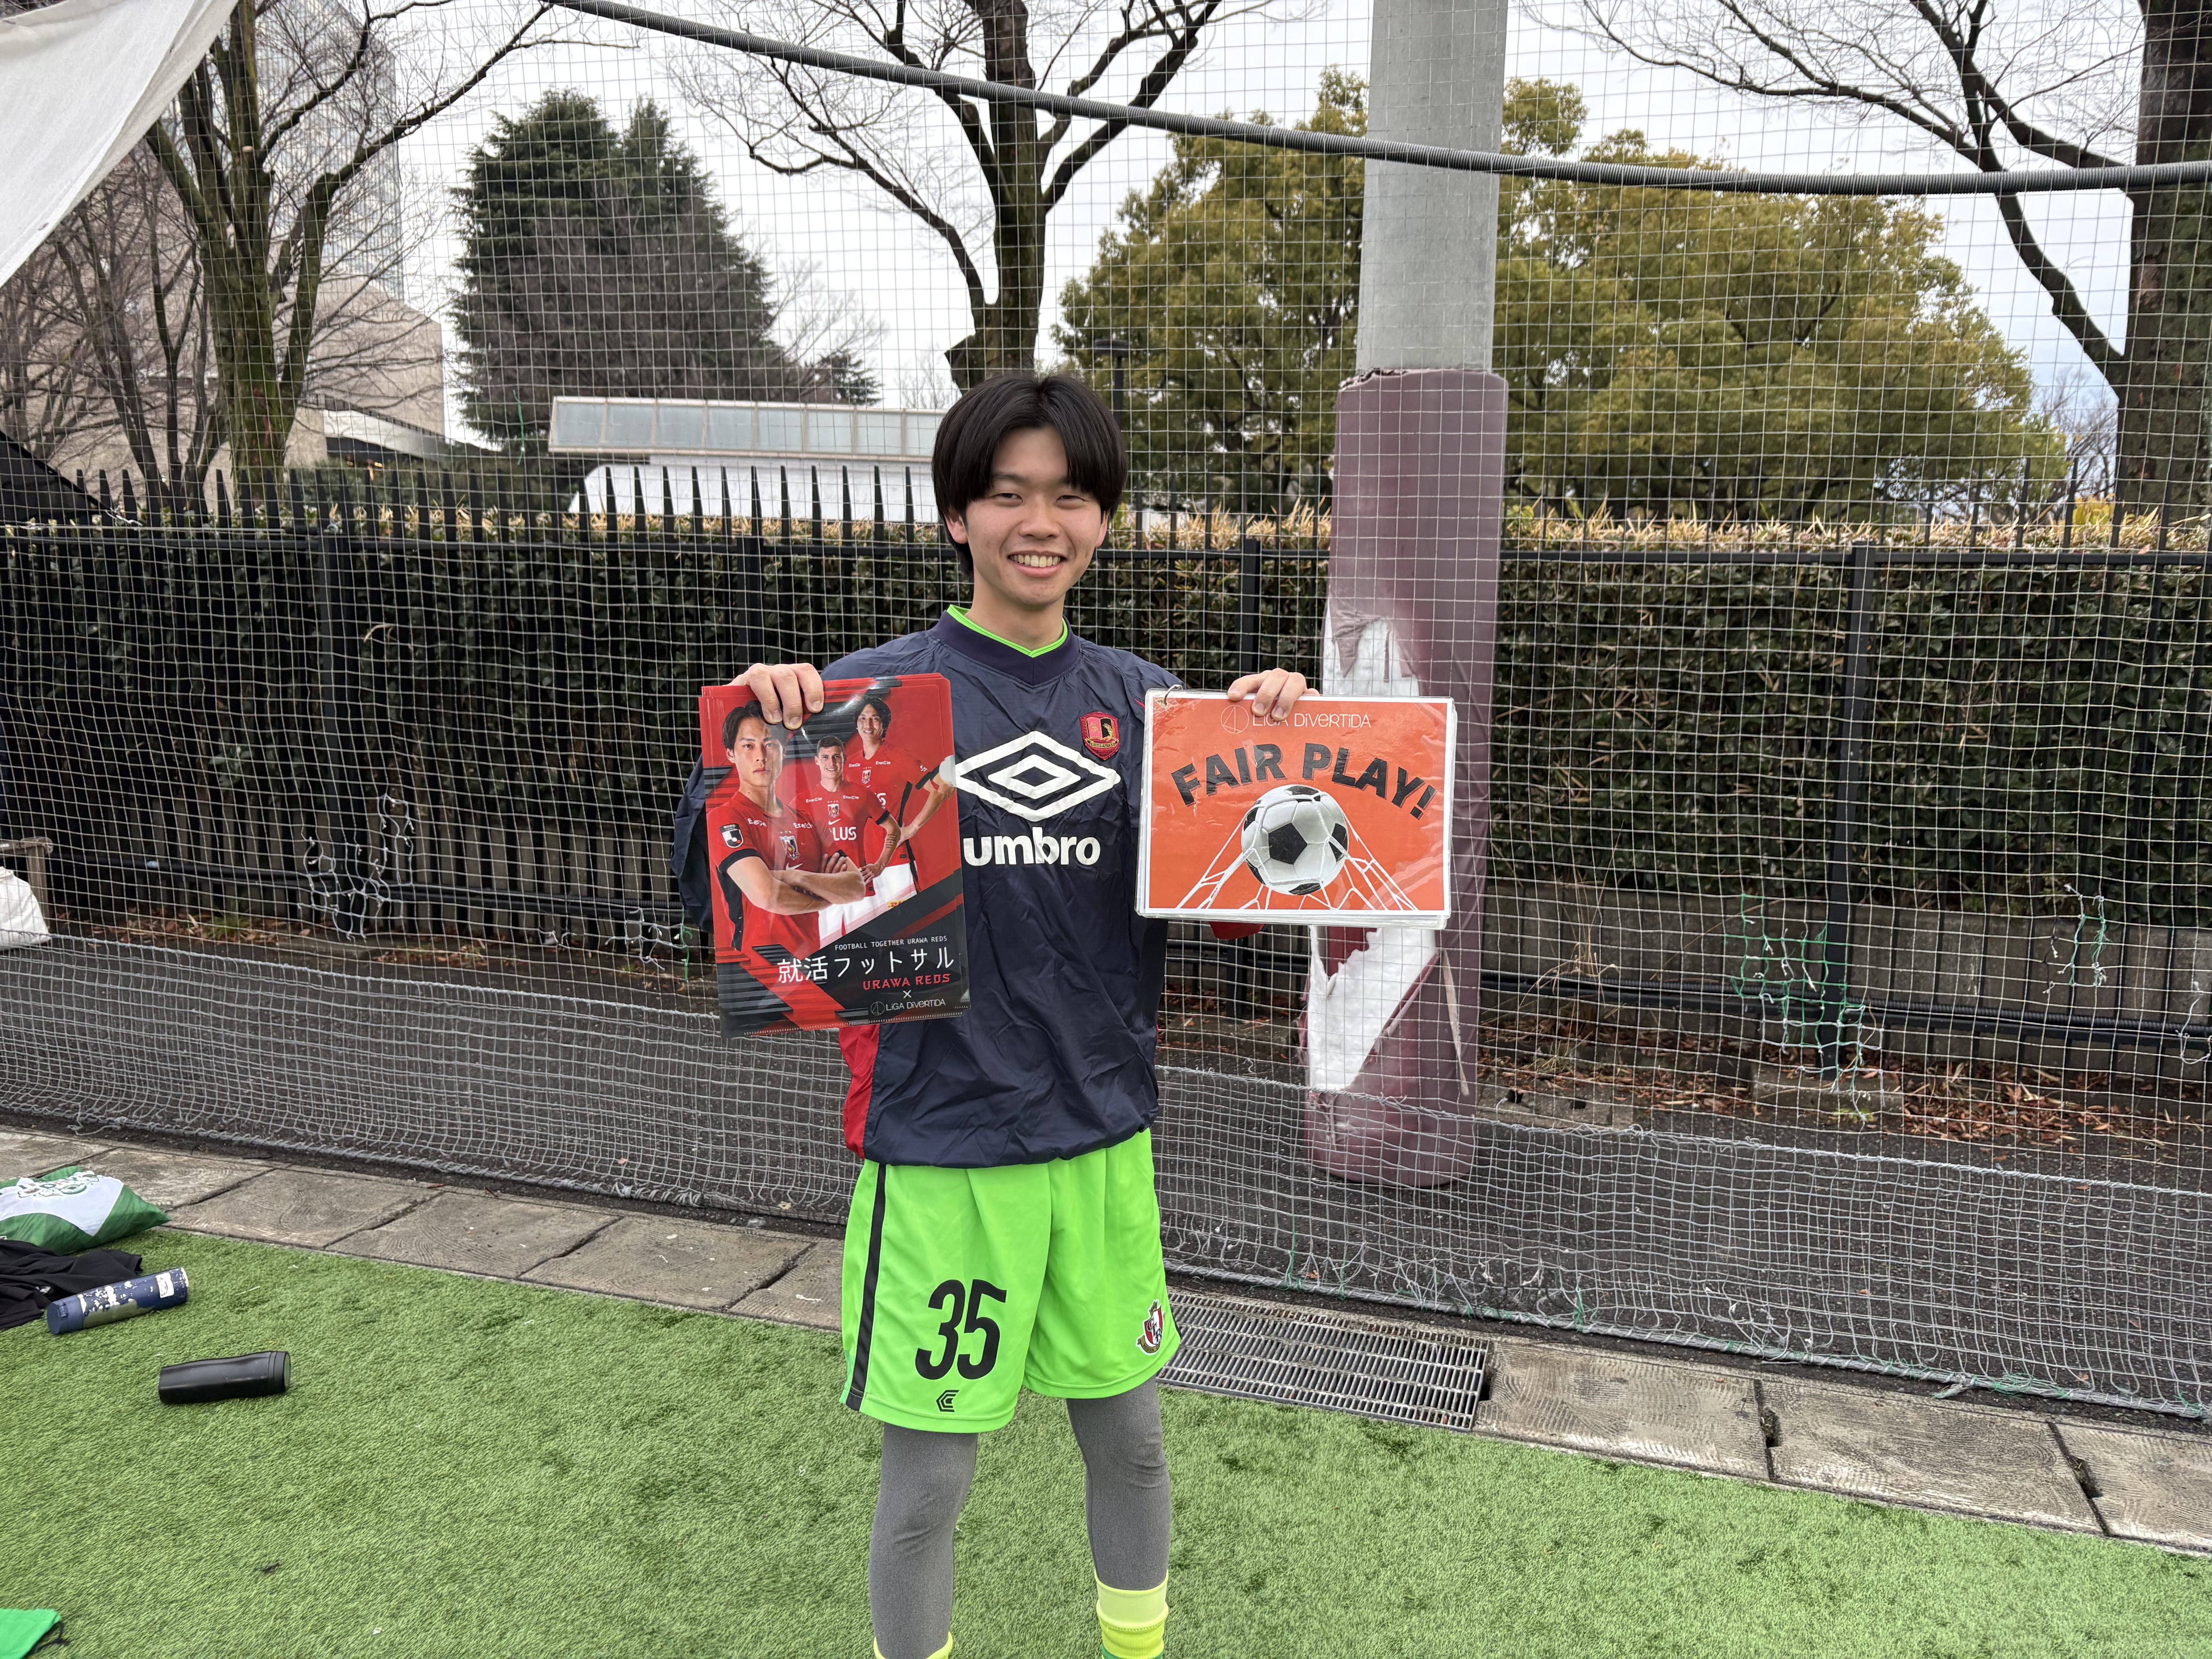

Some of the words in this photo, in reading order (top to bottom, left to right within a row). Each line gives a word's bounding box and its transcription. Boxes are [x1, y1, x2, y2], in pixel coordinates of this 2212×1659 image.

[1171, 744, 1288, 807] FAIR
[1302, 743, 1437, 820] PLAY!
[828, 826, 857, 841] LUS
[963, 827, 1101, 866] umbro
[835, 942, 867, 951] FOOTBALL
[871, 939, 904, 947] TOGETHER
[777, 947, 954, 983] 就活フットサル
[863, 977, 911, 990] URAWA
[915, 973, 951, 985] REDS
[915, 1279, 1007, 1380] 35
